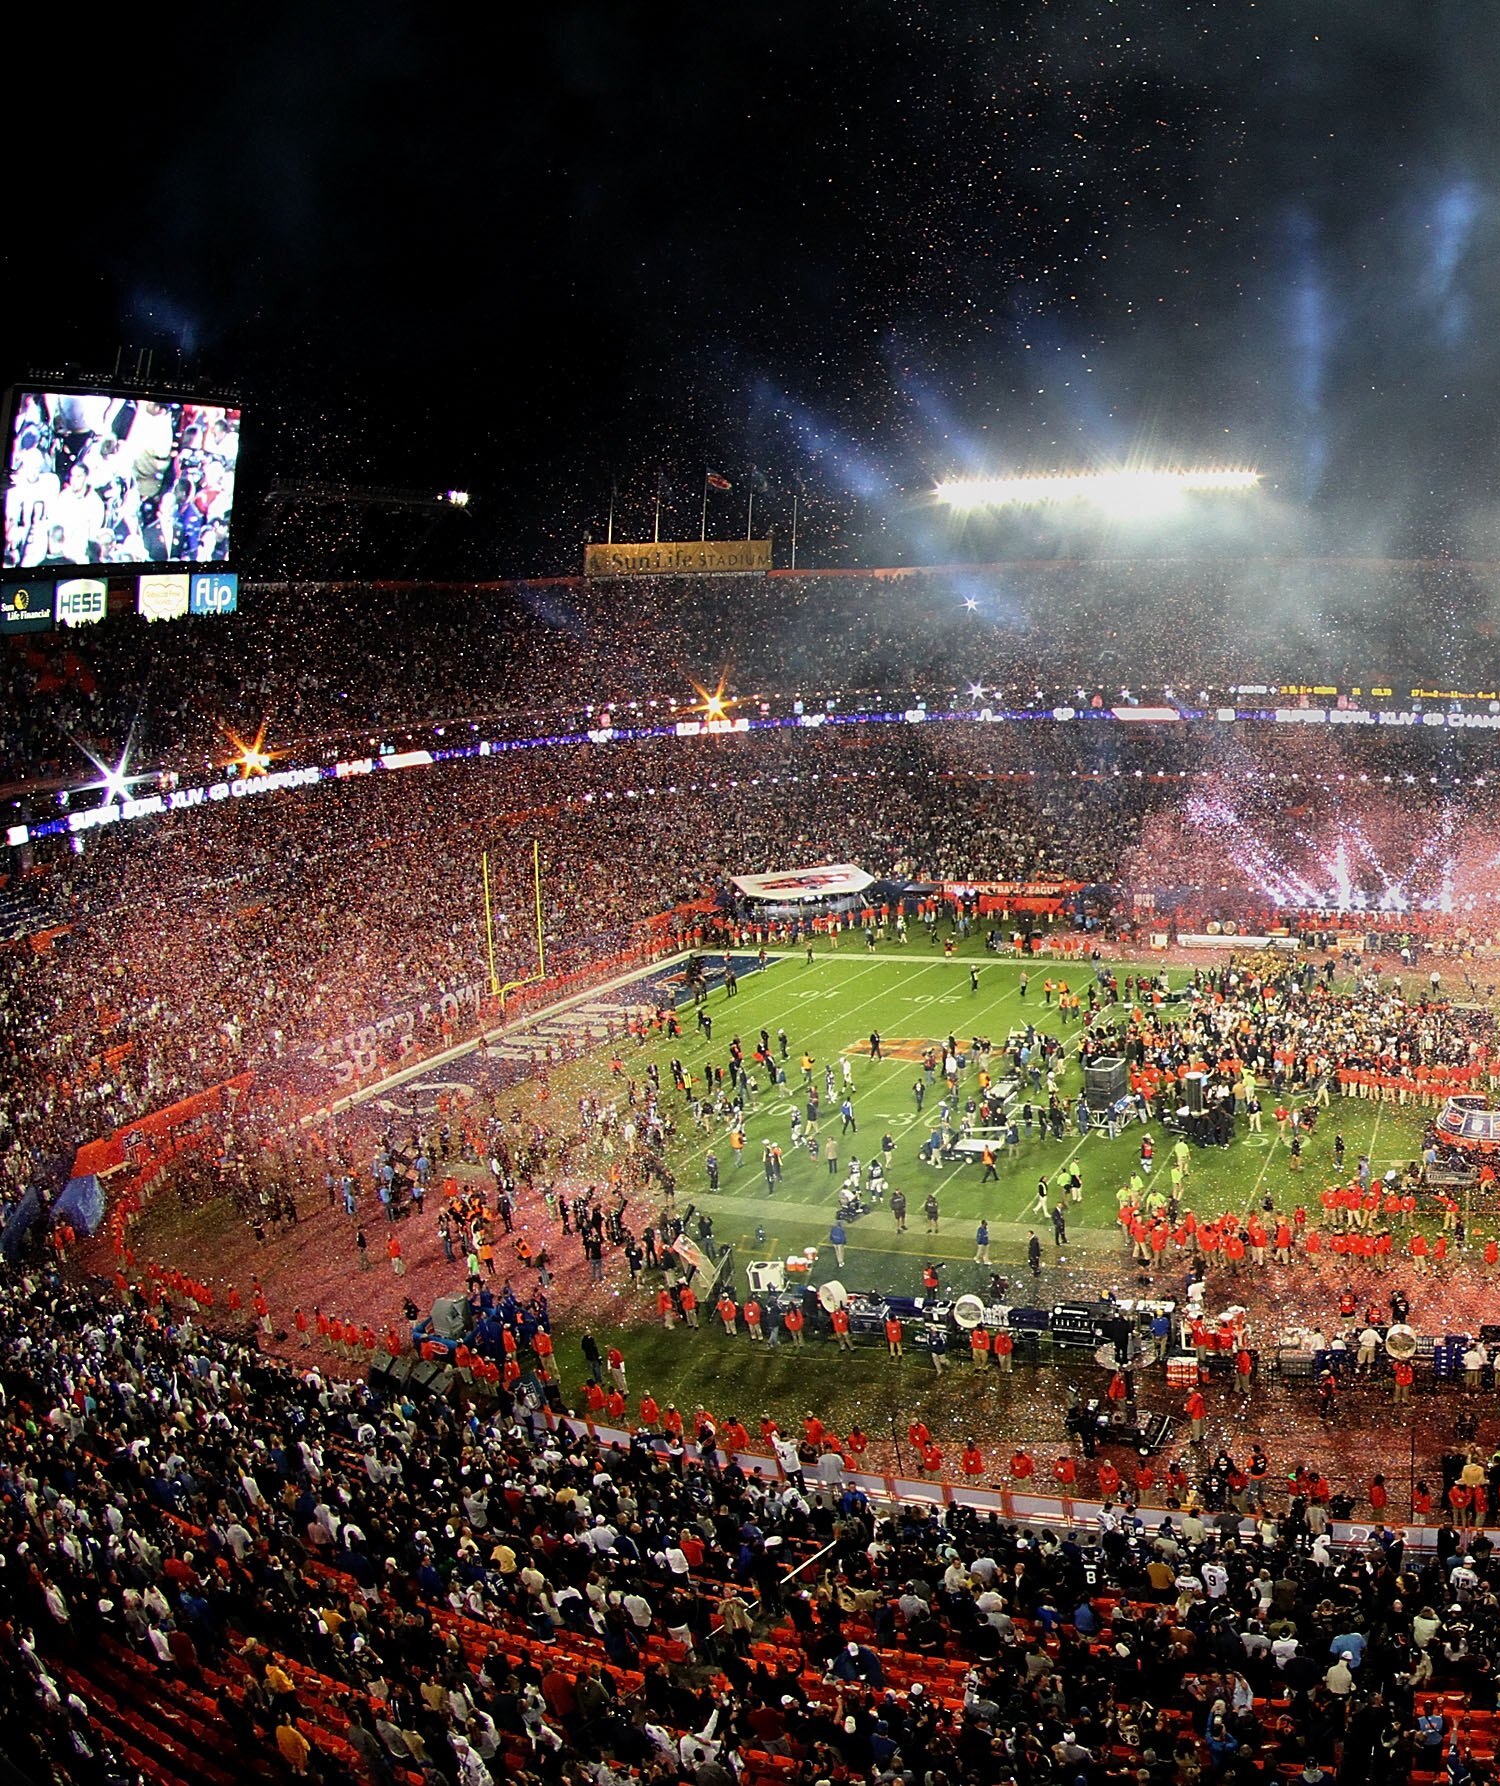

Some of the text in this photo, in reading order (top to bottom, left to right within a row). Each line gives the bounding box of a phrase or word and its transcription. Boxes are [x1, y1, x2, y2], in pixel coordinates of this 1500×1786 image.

[612, 550, 768, 569] Sun Life STADIUM
[1, 603, 15, 613] Sun
[60, 592, 103, 614] HESS
[20, 608, 51, 620] Financial
[231, 766, 320, 798] CHAMPIONS
[1086, 1571, 1096, 1585] 8
[1208, 1574, 1216, 1587] 9
